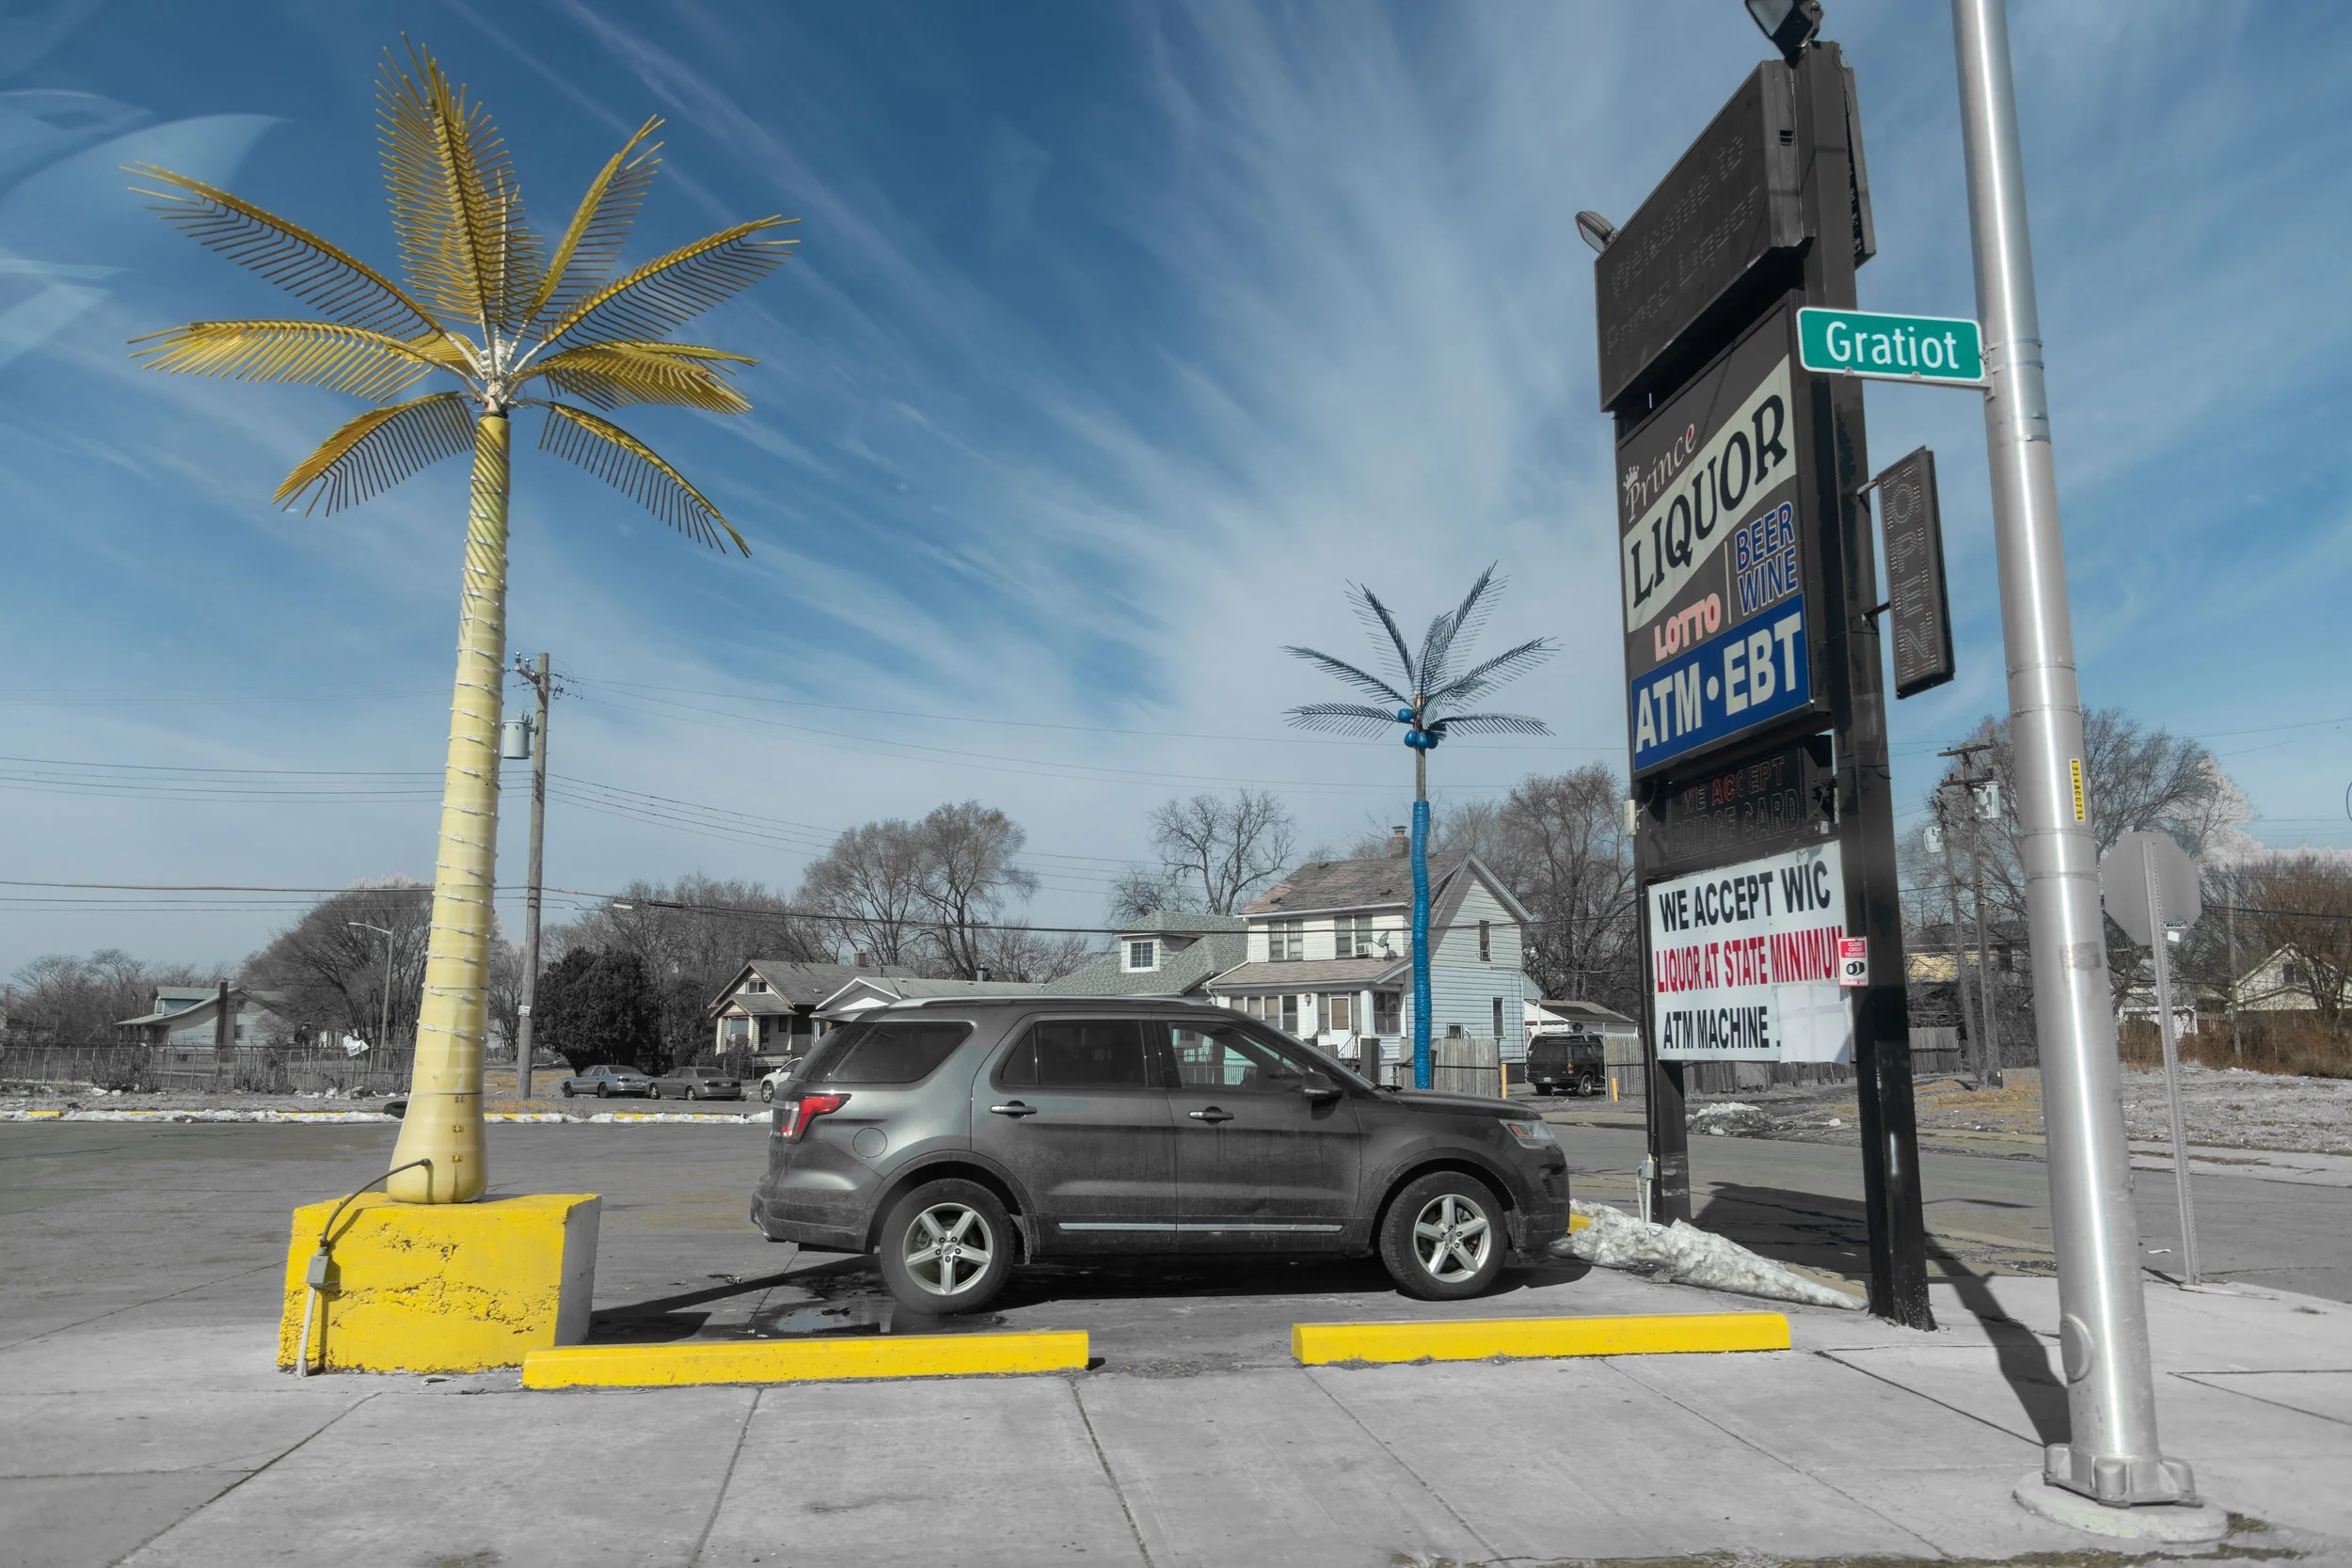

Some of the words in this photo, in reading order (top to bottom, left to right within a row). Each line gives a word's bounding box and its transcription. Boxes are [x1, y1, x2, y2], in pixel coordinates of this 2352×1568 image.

[1826, 321, 1960, 370] Gratiot
[1625, 423, 1697, 523] Prince
[1630, 394, 1788, 609] LIQUOR
[1735, 501, 1795, 574] BEER
[1738, 546, 1799, 616] WINE
[1893, 483, 1929, 664] OPEN
[1654, 593, 1722, 662] LOTTO
[1682, 784, 1707, 815] WE
[1711, 756, 1785, 806] ACCEPT
[1672, 806, 1737, 860] BRIDGE
[1742, 788, 1801, 840] CARD
[1659, 890, 1690, 932] WE
[1694, 871, 1773, 927] ACCEPT
[1780, 861, 1831, 913] WIC
[1656, 945, 1701, 994] LIQUOR
[1705, 942, 1719, 990] AT
[1724, 936, 1768, 988] STATE
[1663, 1011, 1693, 1049] ATM
[1697, 1006, 1770, 1049] MACHINE
